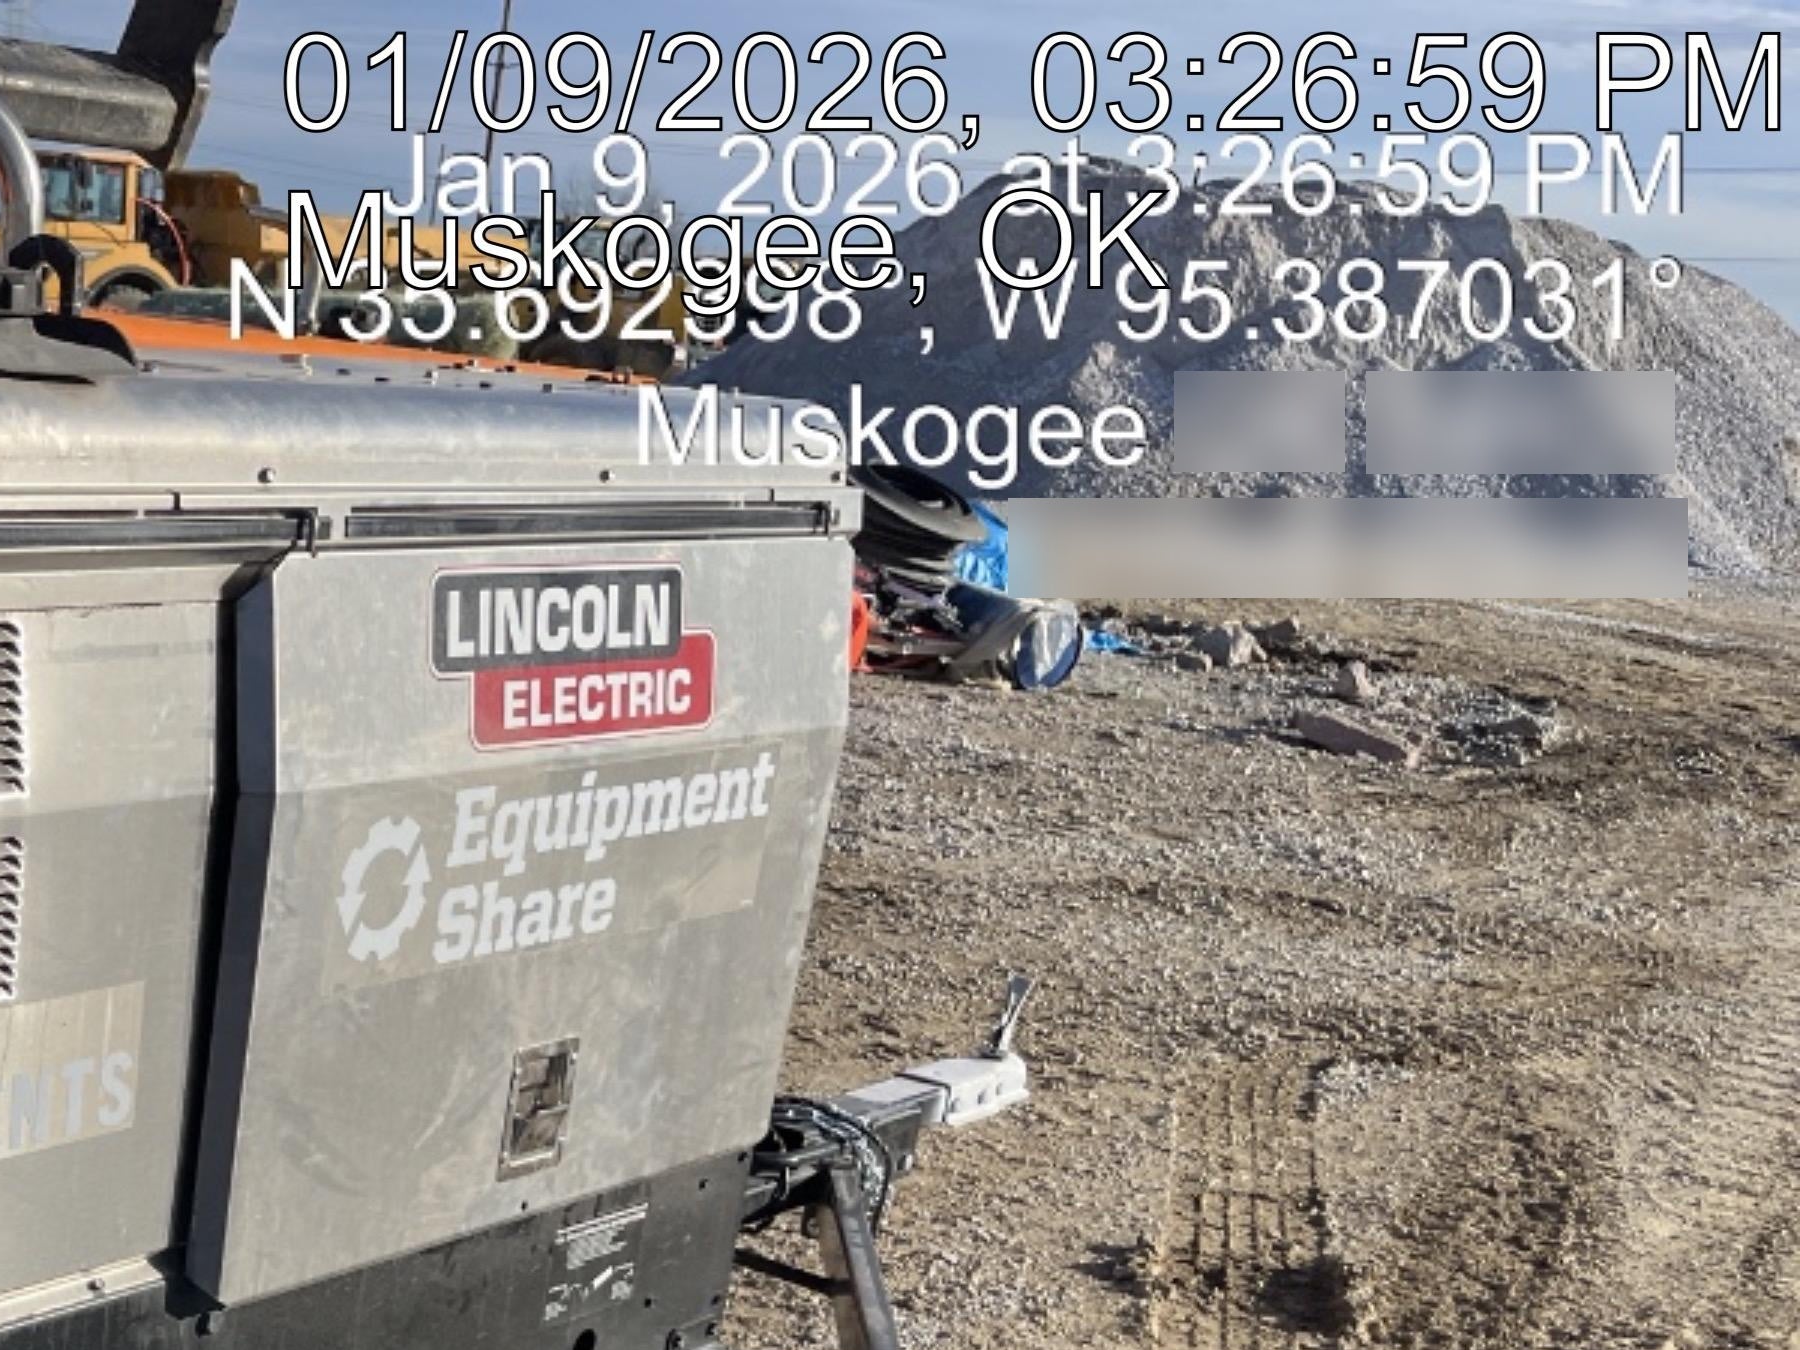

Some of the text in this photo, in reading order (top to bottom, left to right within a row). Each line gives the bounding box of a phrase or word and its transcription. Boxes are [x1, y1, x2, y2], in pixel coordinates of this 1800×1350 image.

[444, 582, 671, 659] LINCOLN
[502, 667, 692, 731] ELECTRIC
[445, 752, 776, 878] Equipment
[431, 877, 616, 963] Share
